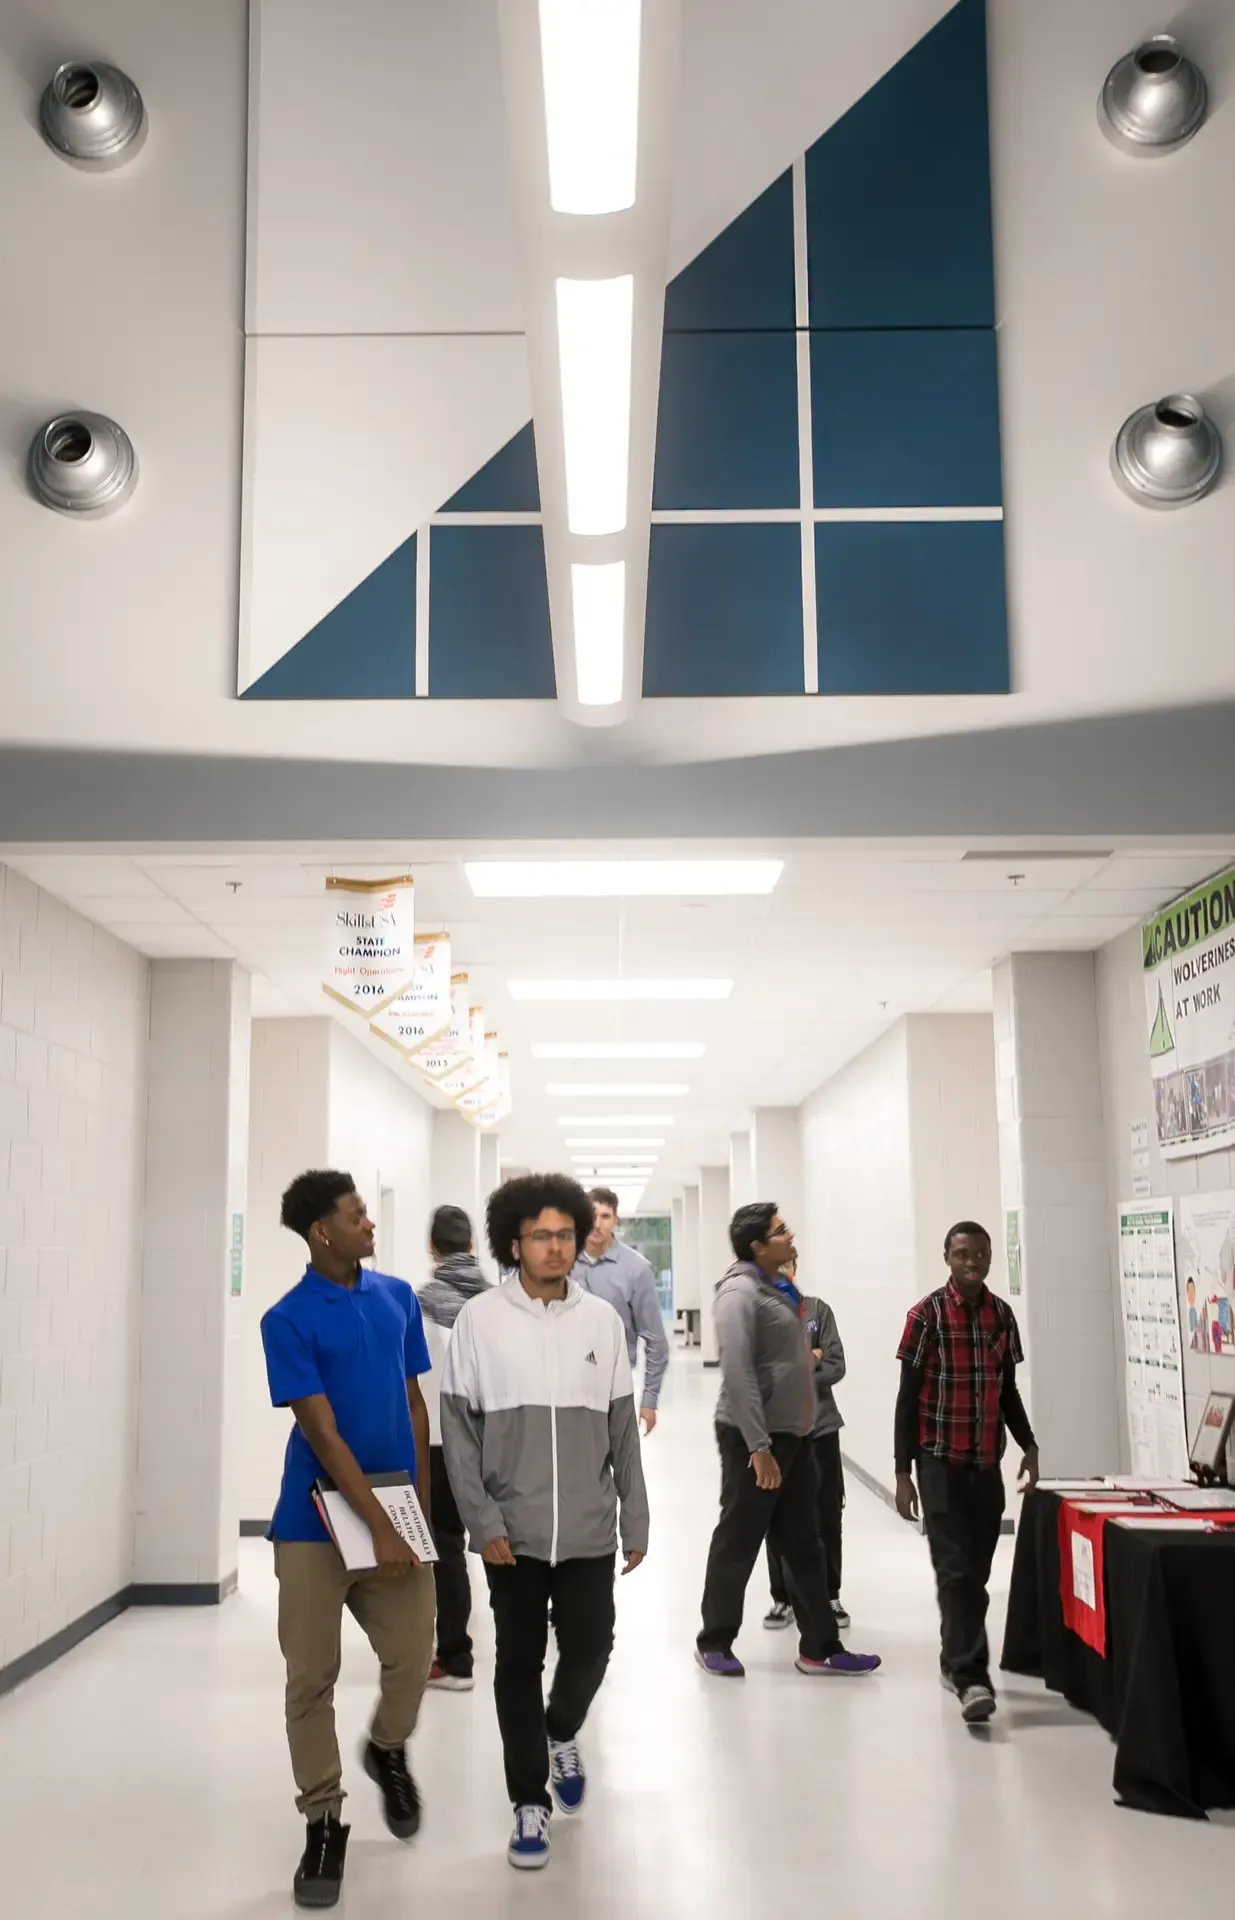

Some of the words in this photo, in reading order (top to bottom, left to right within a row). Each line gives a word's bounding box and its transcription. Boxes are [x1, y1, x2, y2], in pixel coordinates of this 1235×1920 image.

[1154, 879, 1235, 961] CAUTION
[339, 946, 401, 958] CHAMPION
[356, 936, 385, 946] STATE
[1173, 938, 1235, 986] WOLVERINES
[354, 984, 385, 995] 2016
[1176, 997, 1190, 1020] AT
[1192, 982, 1221, 1014] WORK
[398, 1025, 425, 1036] 2016
[399, 1506, 416, 1541] RELATED
[403, 1490, 432, 1556] OCCUPATIONALLY
